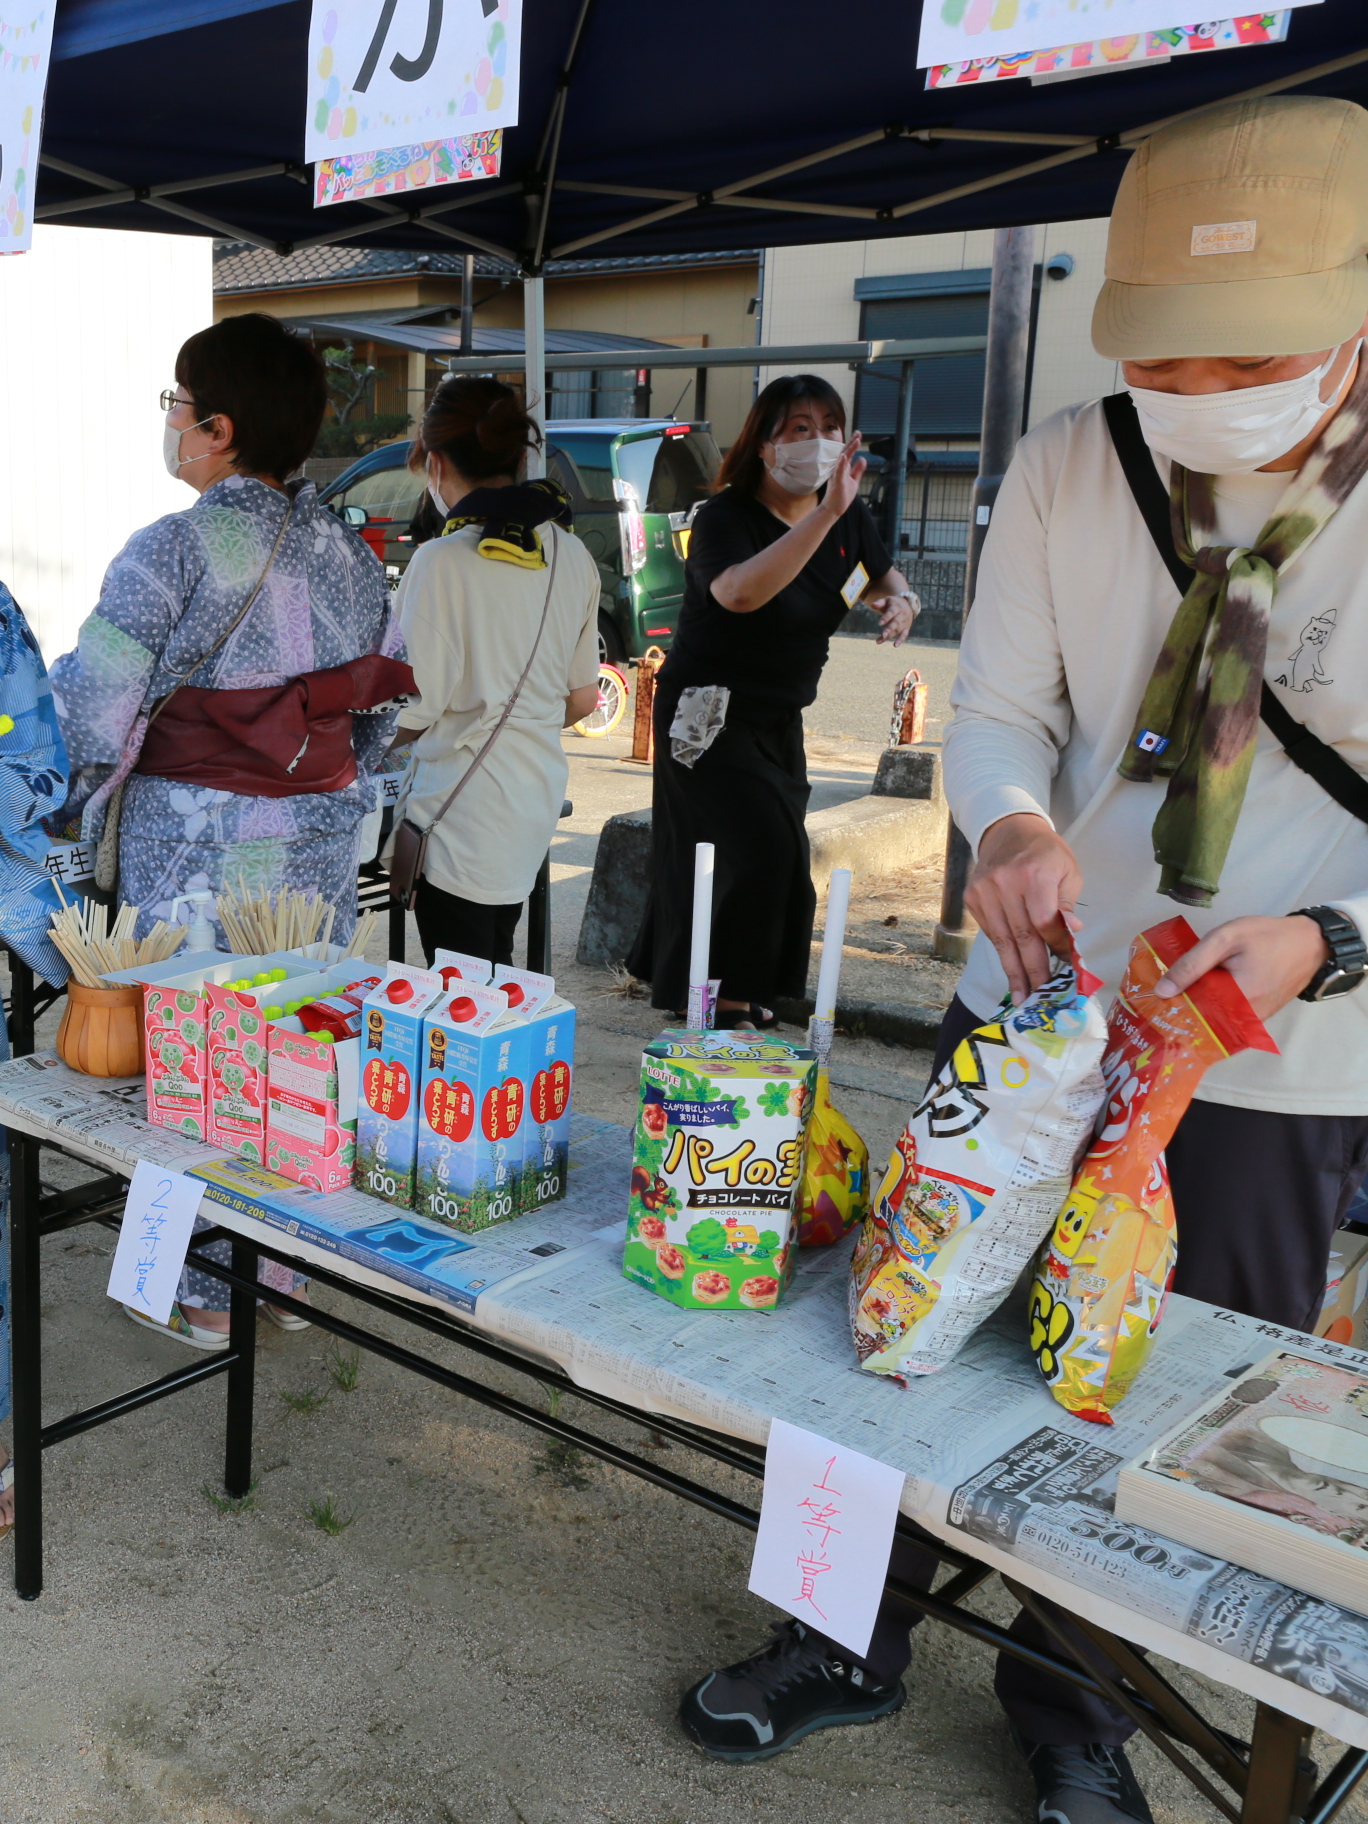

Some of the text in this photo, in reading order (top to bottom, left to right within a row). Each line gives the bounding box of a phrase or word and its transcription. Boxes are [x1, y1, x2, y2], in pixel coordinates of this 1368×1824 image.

[545, 1025, 558, 1056] 青森
[668, 1045, 798, 1059] パイの実
[497, 1041, 511, 1072] 青森
[168, 1081, 183, 1090] Qoo
[370, 1060, 381, 1107] 葉とらず
[397, 1072, 406, 1094] 青森
[553, 1066, 565, 1114] 青研の
[647, 1066, 680, 1087] LOTTE
[381, 1069, 394, 1113] 青研の
[431, 1081, 443, 1128] 葉とらず
[460, 1093, 470, 1115] 青森
[539, 1072, 547, 1120] 葉とらず
[229, 1103, 243, 1113] Qoo
[443, 1090, 457, 1134] 青研の
[506, 1083, 519, 1131] 青研の
[663, 1102, 730, 1113] こんがり香ばしいパイ、
[679, 1113, 715, 1123] 実りました。
[294, 1159, 307, 1169] Qoo
[664, 1129, 803, 1187] パイの実
[367, 1170, 396, 1196] 100
[536, 1176, 560, 1201] 100
[932, 1180, 959, 1205] ベビースター
[211, 1189, 265, 1219] 0120-181-209
[428, 1193, 458, 1220] 100
[487, 1196, 512, 1221] 100
[697, 1194, 788, 1204] チョコレート パイ
[921, 1182, 959, 1214] ドデカイ
[132, 1179, 173, 1306] 2等賞
[880, 1277, 917, 1311] メープル
[896, 1271, 927, 1298] ドデカイ
[902, 1271, 928, 1294] ベビースター
[875, 1280, 911, 1315] シロップ
[792, 1455, 842, 1621] 1等賞
[1067, 1518, 1191, 1579] 500円
